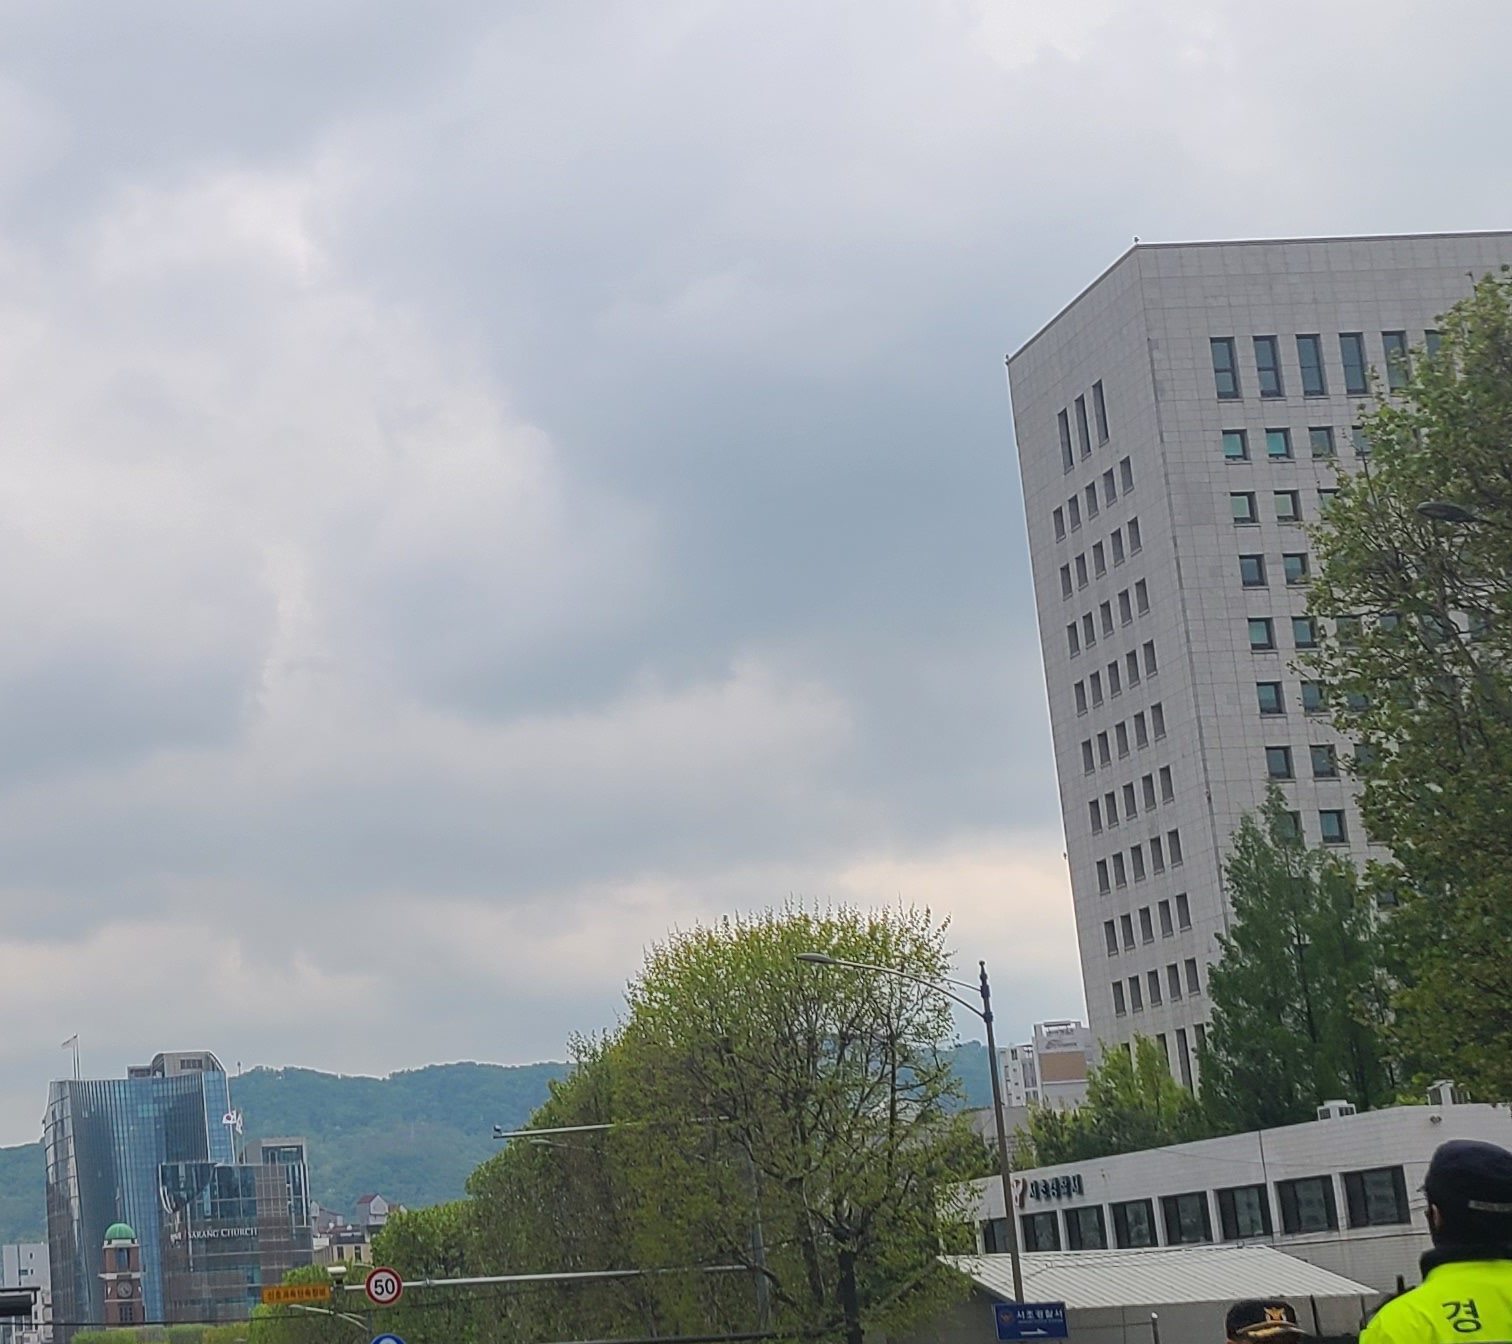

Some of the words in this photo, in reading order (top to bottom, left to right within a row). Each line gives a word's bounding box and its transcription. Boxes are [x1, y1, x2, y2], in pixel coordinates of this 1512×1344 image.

[221, 1227, 258, 1237] CHURCH
[374, 1278, 396, 1296] 50
[1442, 1299, 1482, 1333] 경
